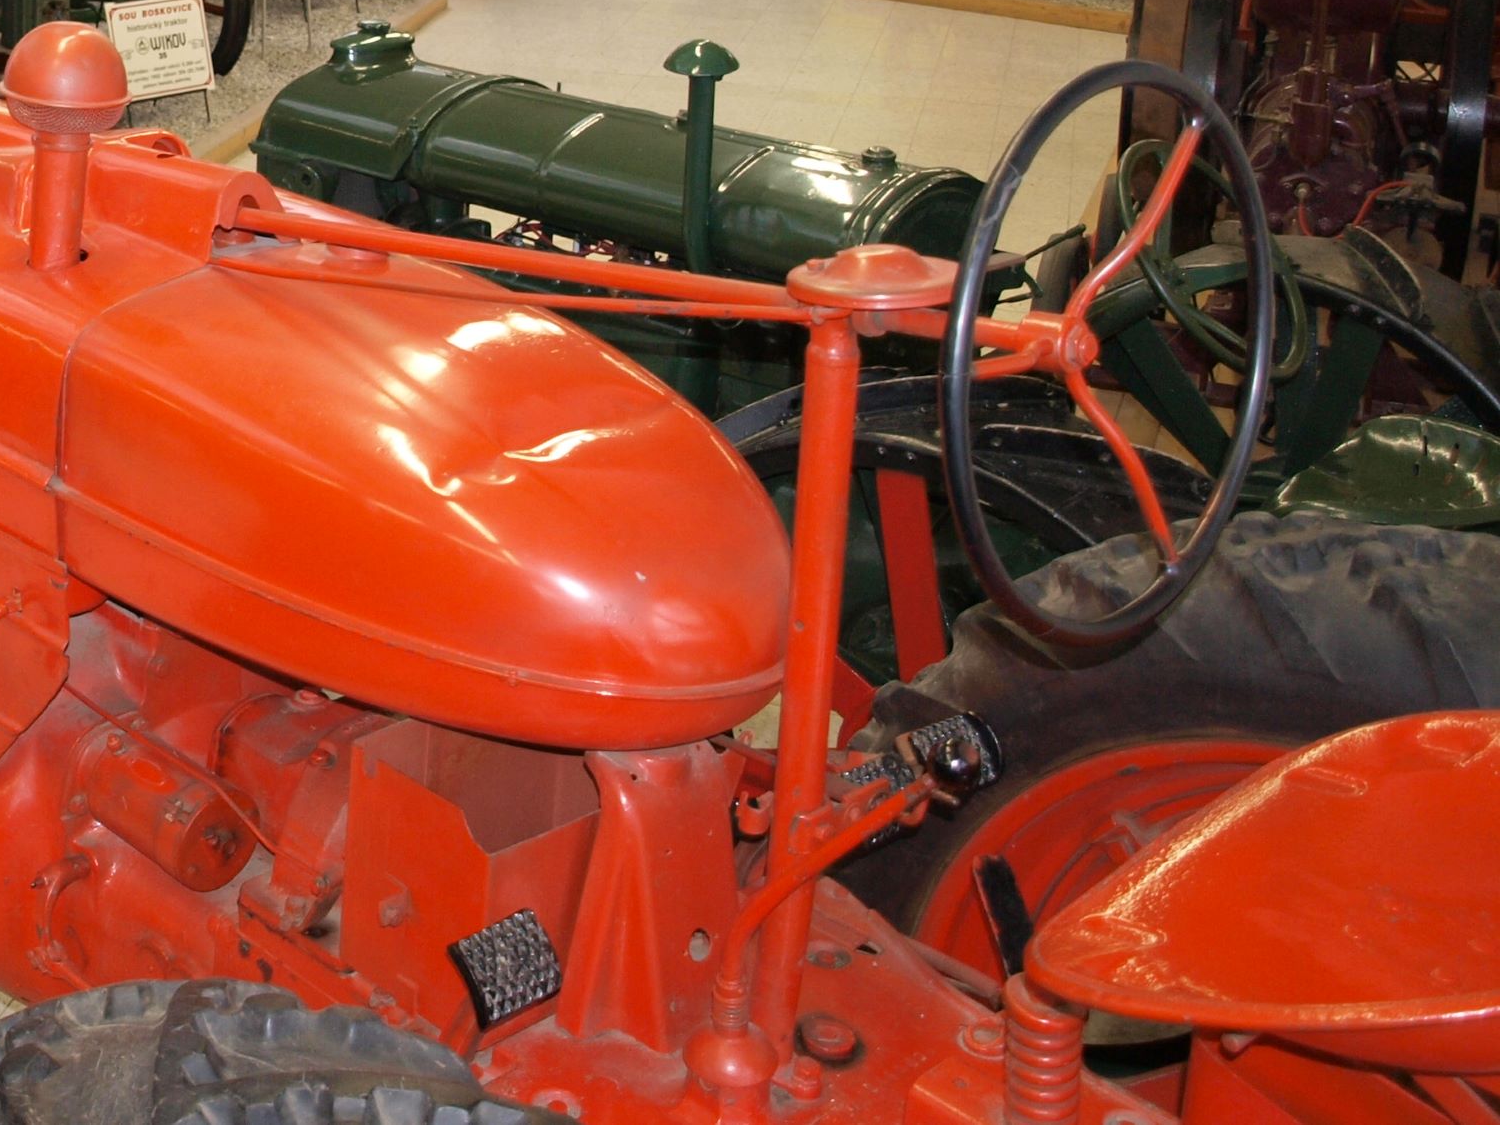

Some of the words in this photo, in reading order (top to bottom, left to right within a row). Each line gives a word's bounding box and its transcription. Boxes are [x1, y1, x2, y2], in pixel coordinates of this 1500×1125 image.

[118, 12, 138, 21] SOU
[142, 3, 193, 18] BOSKOVICE
[149, 32, 187, 51] WIKOV
